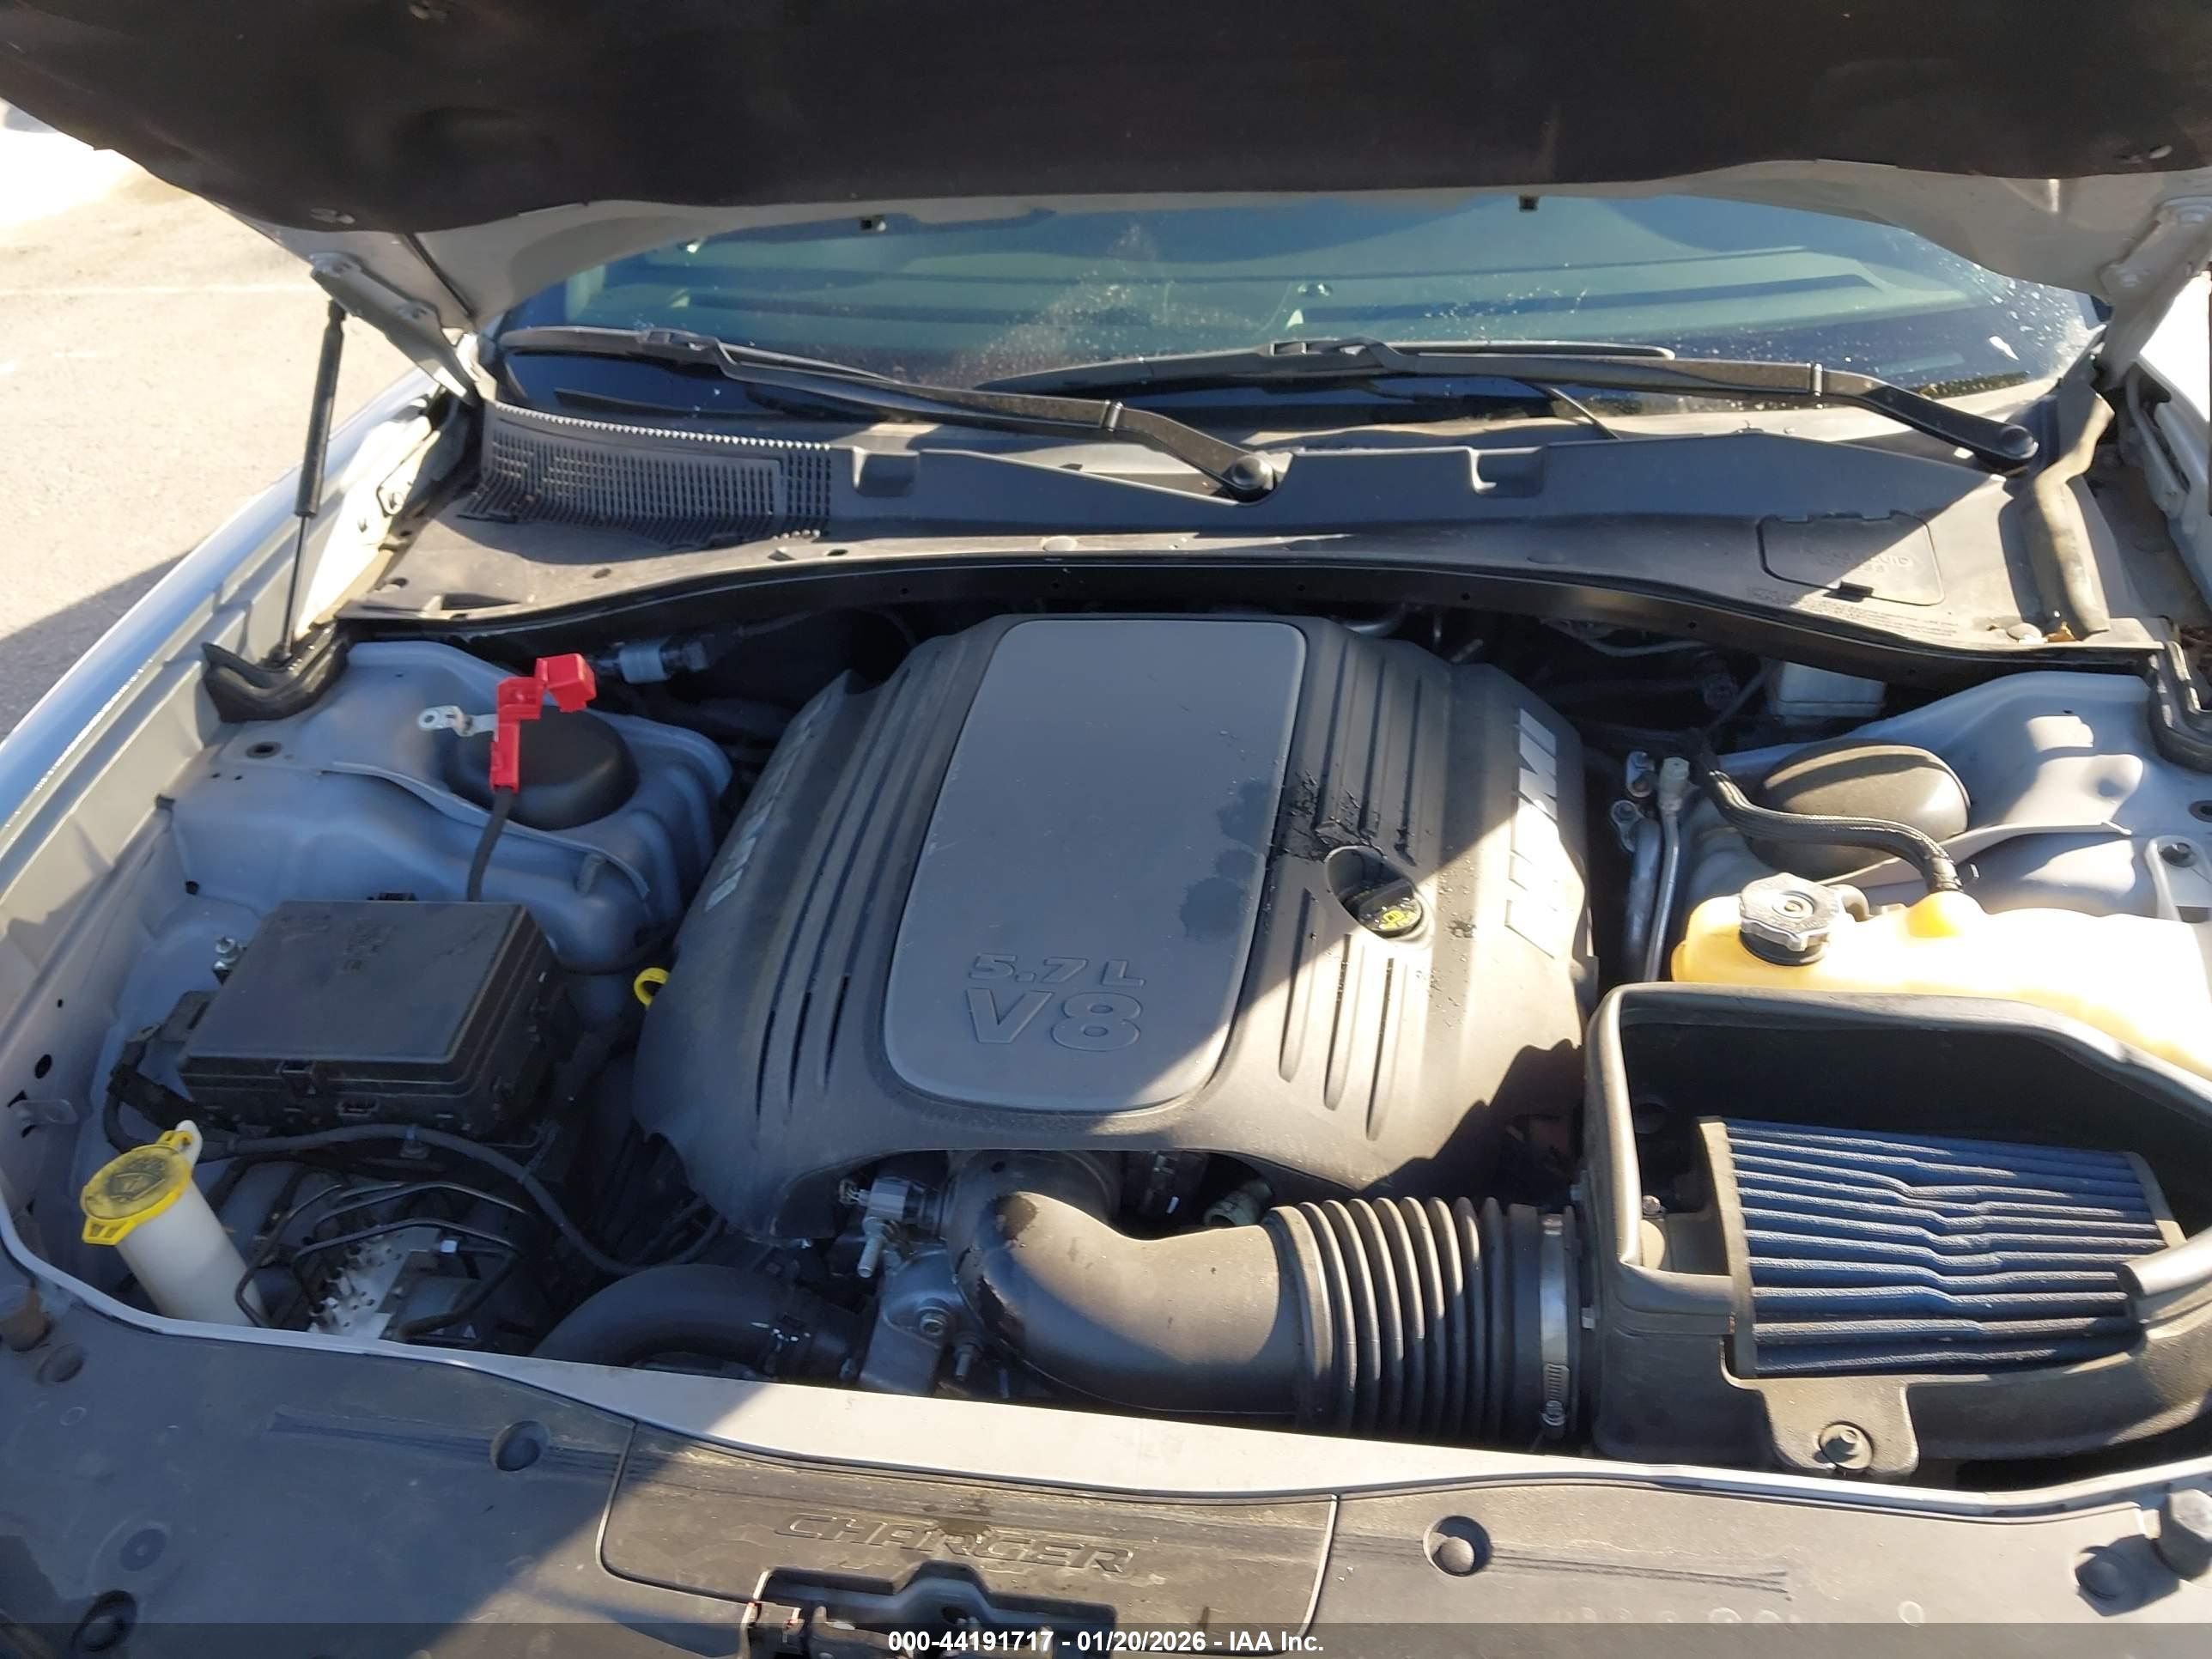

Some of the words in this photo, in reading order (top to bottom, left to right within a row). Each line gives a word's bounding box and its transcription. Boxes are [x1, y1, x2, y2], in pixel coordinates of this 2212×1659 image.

[968, 952, 1089, 984] 5.7
[1100, 958, 1146, 988] L
[965, 987, 1144, 1052] V8
[775, 1512, 1134, 1573] CHARGER
